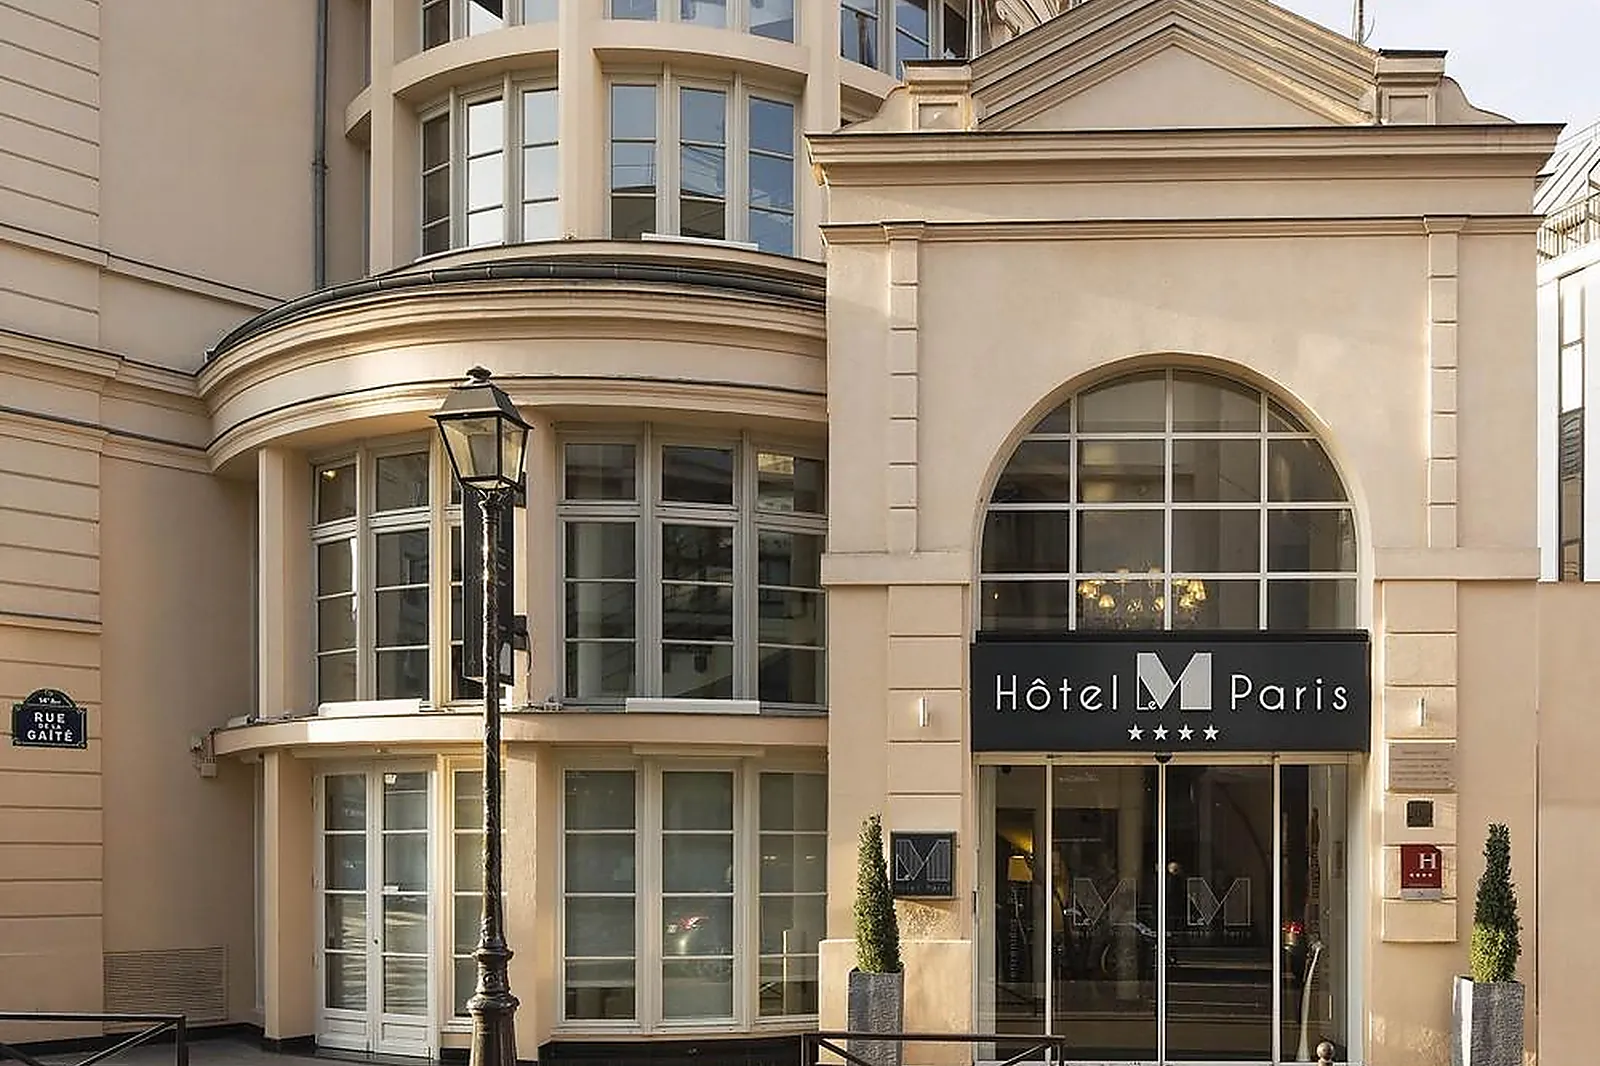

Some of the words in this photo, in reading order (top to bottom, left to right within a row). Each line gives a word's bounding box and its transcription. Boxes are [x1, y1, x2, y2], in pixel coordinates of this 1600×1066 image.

[995, 674, 1118, 711] Hôtel
[1136, 652, 1212, 711] M
[1230, 674, 1349, 711] Paris
[34, 712, 65, 724] RUE
[1419, 853, 1438, 870] H
